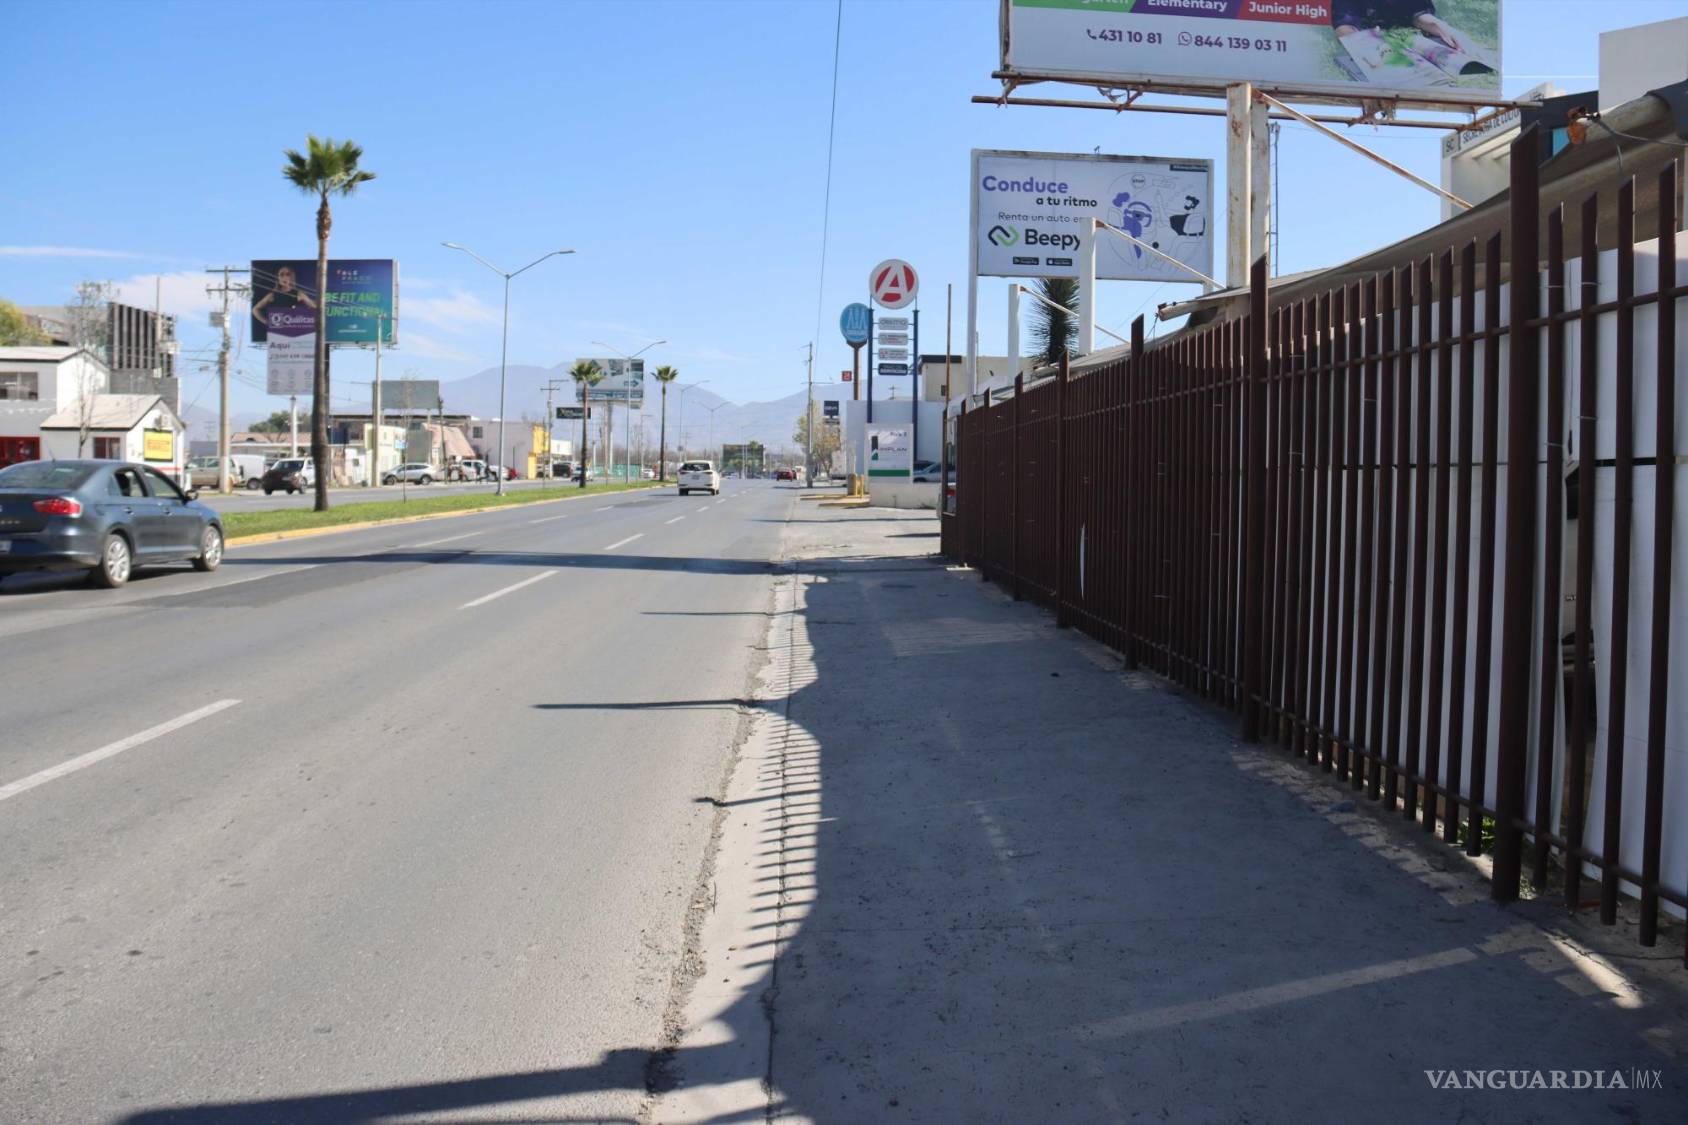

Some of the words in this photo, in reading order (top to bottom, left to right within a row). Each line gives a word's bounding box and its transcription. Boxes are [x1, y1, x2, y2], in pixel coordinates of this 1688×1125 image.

[1148, 0, 1227, 12] Elementary
[1248, 3, 1292, 15] Junior
[1295, 5, 1327, 18] High
[1098, 29, 1122, 42] 431
[1127, 31, 1143, 43] 10
[1147, 32, 1162, 44] 81
[1194, 35, 1223, 48] 844
[1227, 37, 1250, 49] 139
[1254, 39, 1272, 51] 03
[1276, 40, 1287, 52] 11
[982, 175, 1069, 193] Conduce
[1035, 197, 1044, 205] a
[1047, 196, 1060, 206] tu
[1063, 195, 1098, 207] ritmo
[998, 212, 1029, 222] Renta
[1031, 214, 1042, 222] un
[1046, 214, 1070, 223] auto
